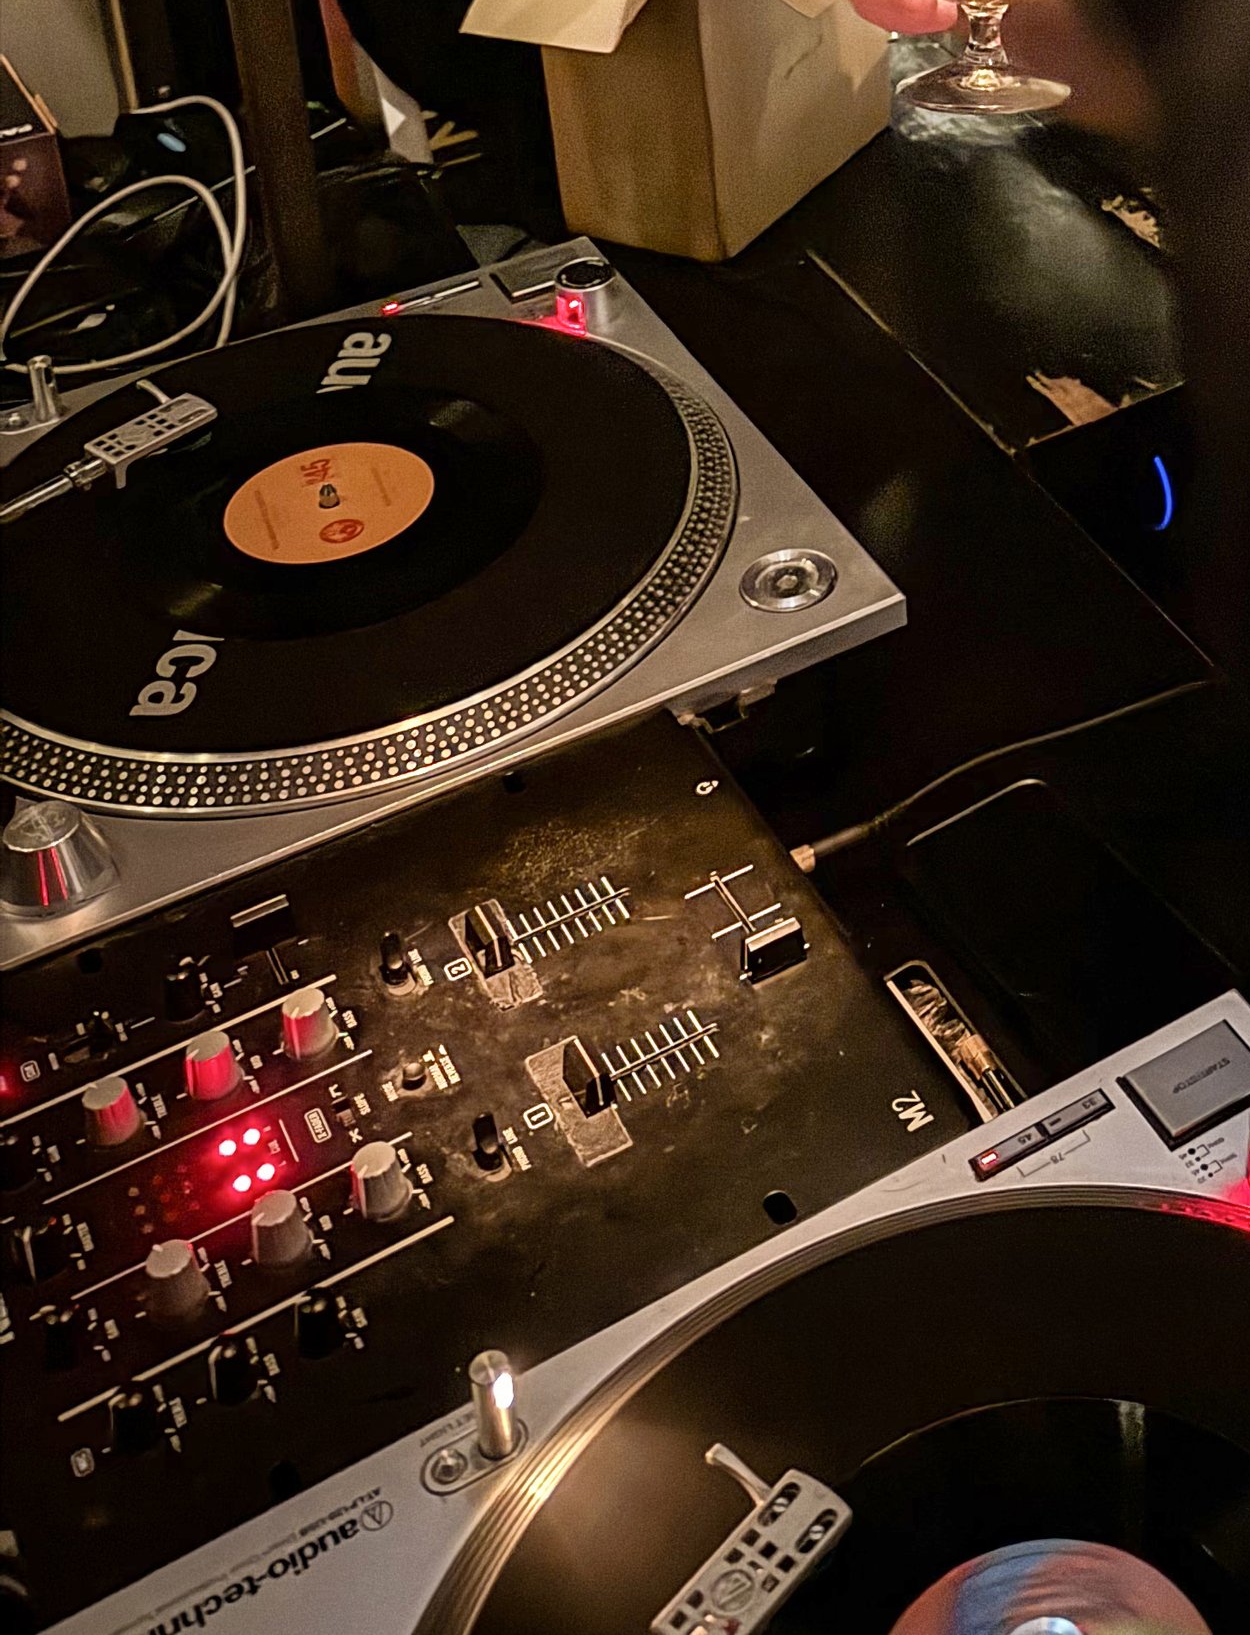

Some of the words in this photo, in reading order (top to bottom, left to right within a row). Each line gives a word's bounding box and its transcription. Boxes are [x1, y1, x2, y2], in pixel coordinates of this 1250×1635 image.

[353, 1092, 371, 1116] SLOPE
[1082, 1098, 1098, 1110] 33
[892, 1090, 934, 1132] M2
[1018, 1132, 1032, 1145] 45
[1050, 1152, 1065, 1164] 78
